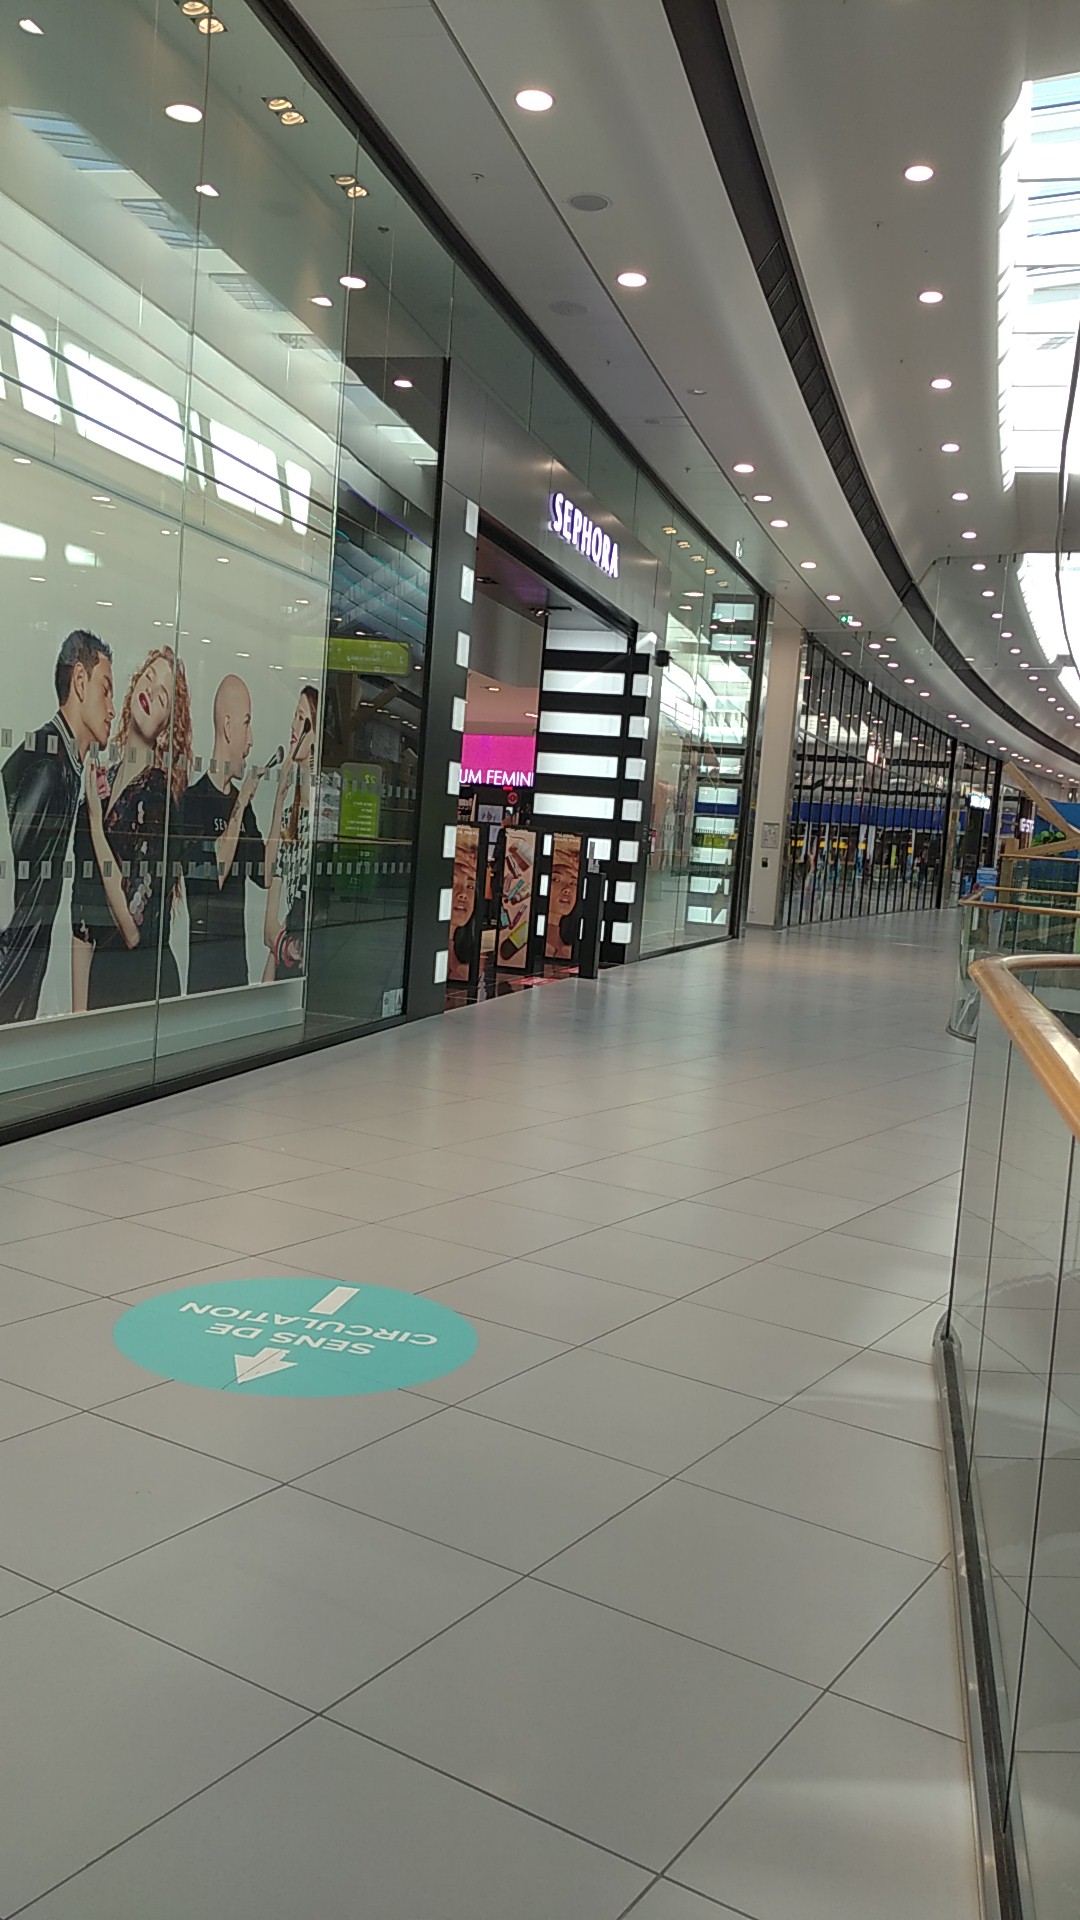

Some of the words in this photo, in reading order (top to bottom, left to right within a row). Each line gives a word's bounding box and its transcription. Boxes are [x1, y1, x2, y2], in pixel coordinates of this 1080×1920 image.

[550, 493, 618, 578] SEPHORA
[178, 1301, 438, 1346] CIRCULATION
[204, 1322, 266, 1341] DE
[271, 1331, 376, 1356] SENS
